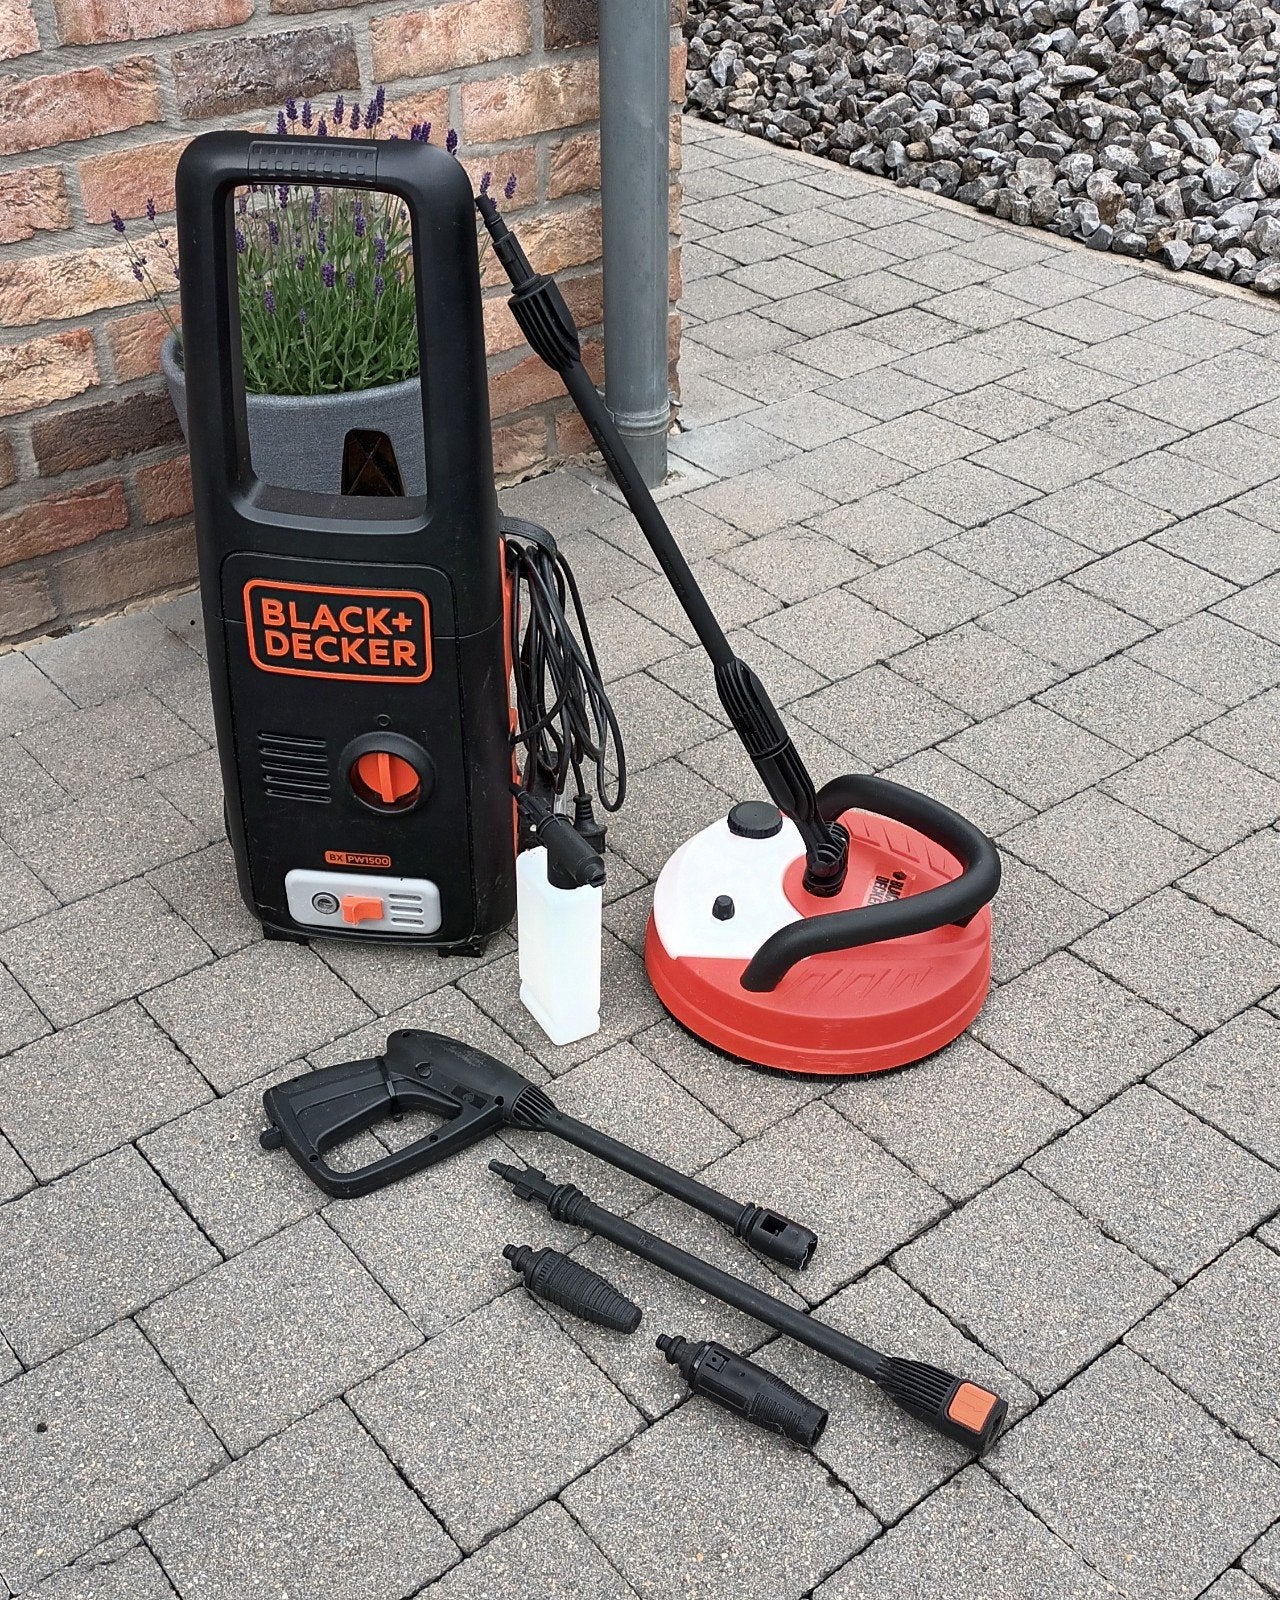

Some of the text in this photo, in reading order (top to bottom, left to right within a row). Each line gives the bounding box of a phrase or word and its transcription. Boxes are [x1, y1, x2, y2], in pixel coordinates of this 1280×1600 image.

[261, 598, 412, 635] BLACK+
[264, 629, 417, 666] DECKER
[329, 853, 389, 865] BX PW1500
[868, 875, 890, 905] DECKE
